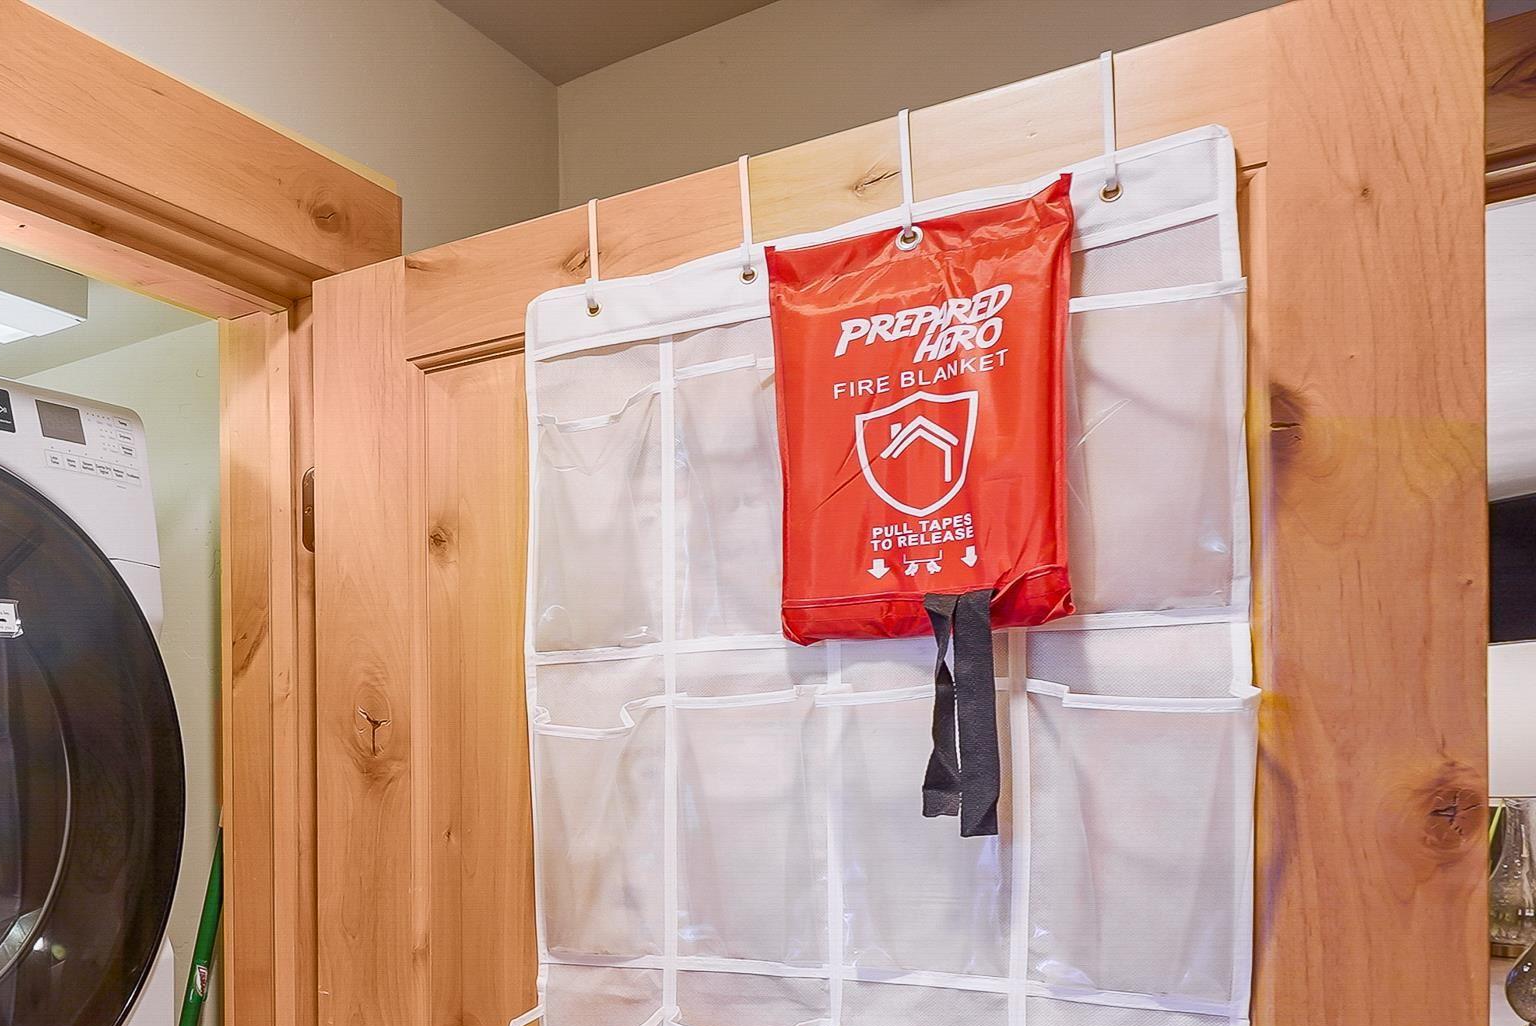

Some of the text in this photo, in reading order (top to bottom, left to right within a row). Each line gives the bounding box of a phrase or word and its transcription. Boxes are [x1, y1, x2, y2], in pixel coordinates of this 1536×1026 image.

[834, 283, 1014, 358] PREPARED
[913, 317, 1004, 365] HERO
[833, 348, 1009, 400] FIRE BLANKET
[870, 525, 974, 552] TO RELEASE
[872, 513, 972, 540] PULL TAPES
